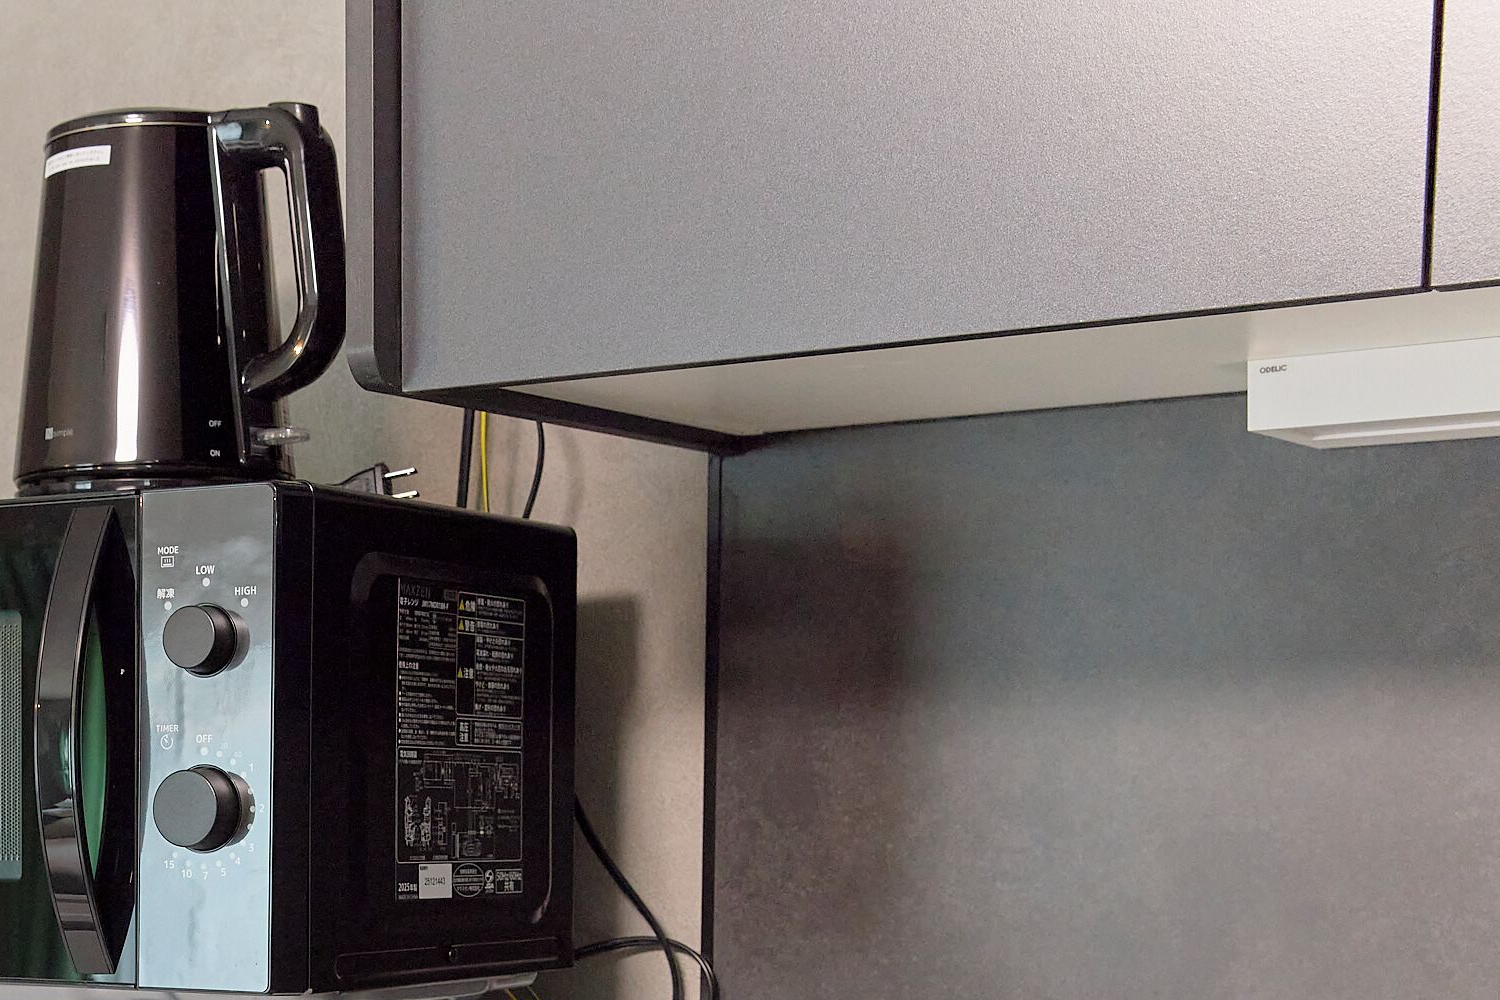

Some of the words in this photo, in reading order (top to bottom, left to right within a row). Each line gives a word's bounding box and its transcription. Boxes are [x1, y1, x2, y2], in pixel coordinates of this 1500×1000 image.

[1259, 364, 1288, 374] ODELIC
[208, 419, 223, 428] OFF
[209, 448, 221, 457] ON
[157, 546, 179, 555] MODE
[195, 565, 216, 575] LOW
[234, 585, 257, 596] HIGH
[399, 596, 419, 607] 電子レンジ
[464, 600, 476, 612] 危険
[464, 620, 476, 632] 警告
[463, 667, 474, 679] 注意
[156, 724, 180, 733] TIMER
[195, 734, 213, 744] OFF
[259, 804, 265, 812] 2
[163, 860, 175, 869] 15
[234, 857, 241, 865] 4
[181, 869, 193, 878] 10
[220, 868, 227, 876] 5
